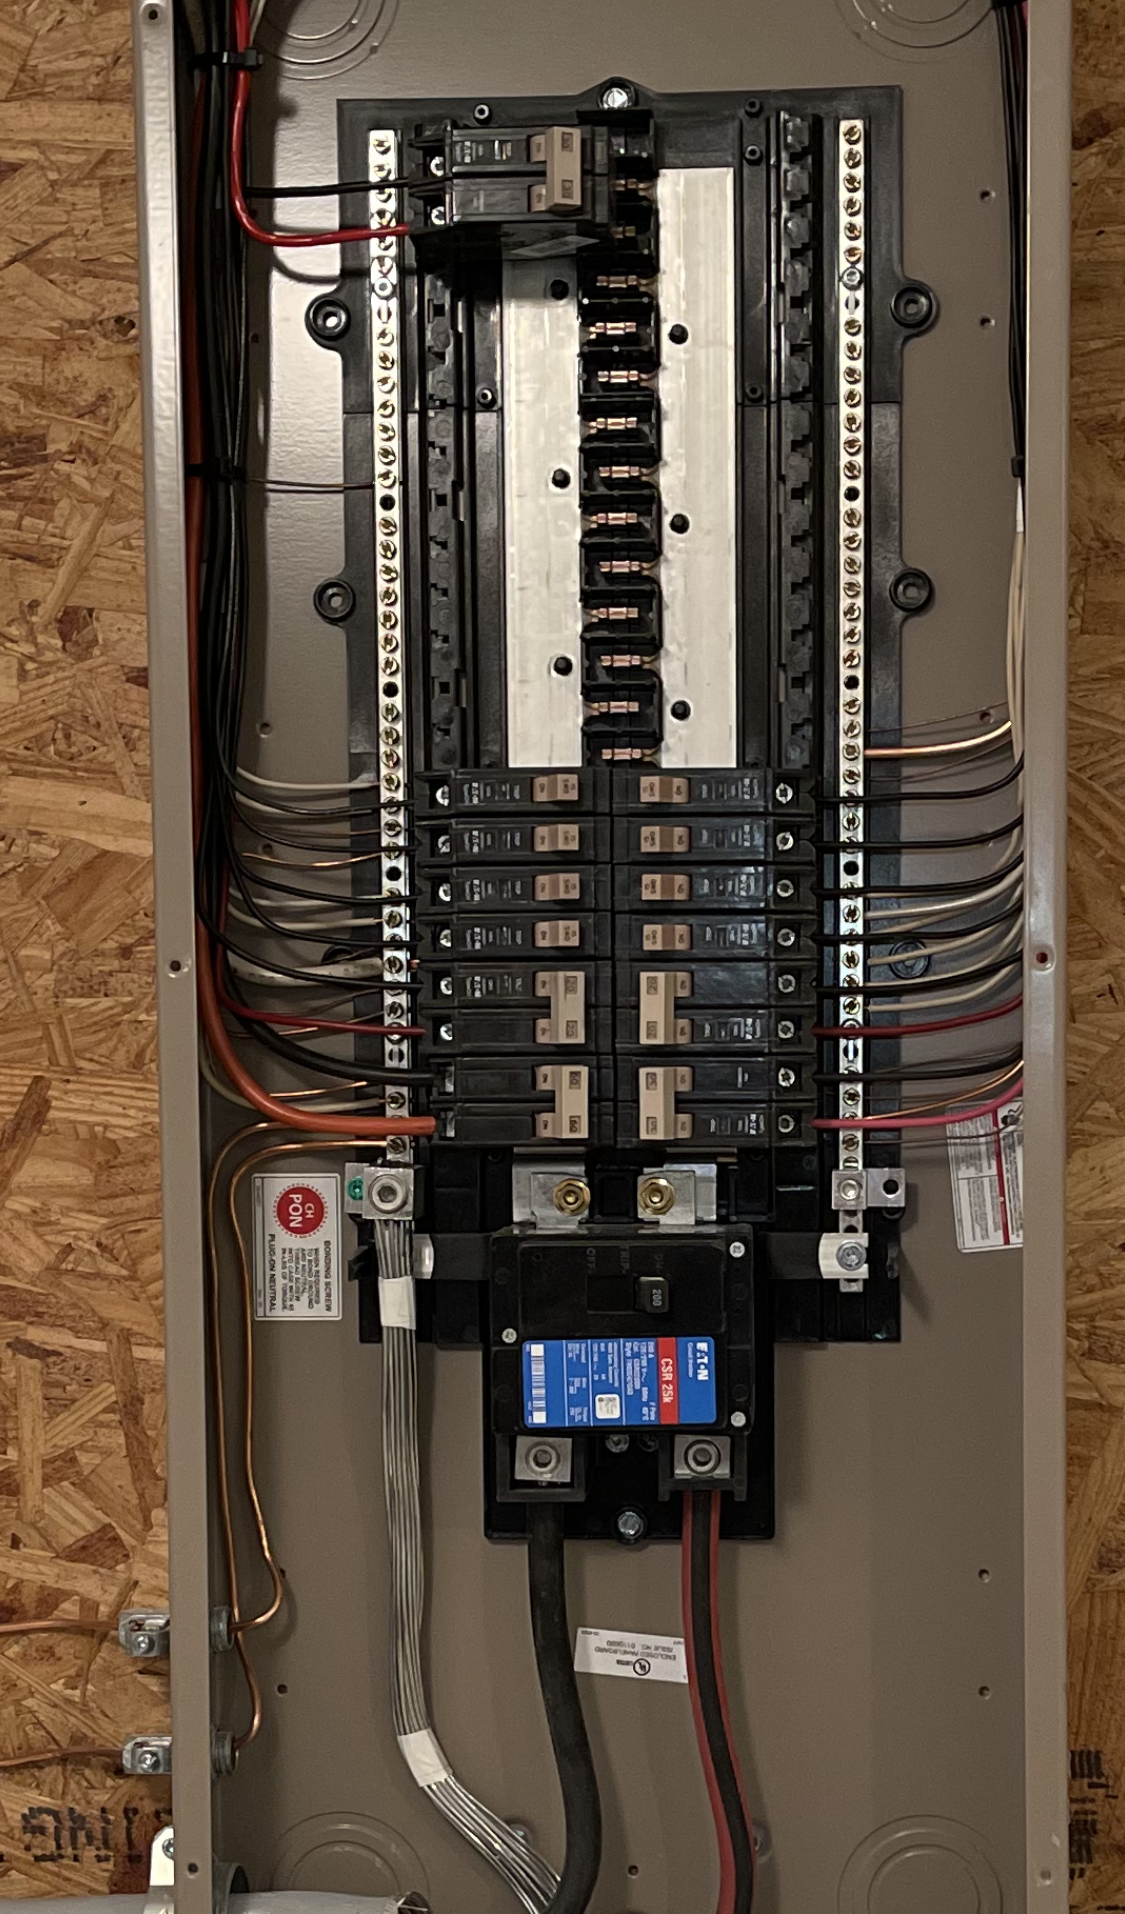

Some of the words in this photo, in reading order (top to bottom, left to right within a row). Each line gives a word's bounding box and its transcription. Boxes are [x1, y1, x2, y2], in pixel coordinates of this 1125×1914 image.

[289, 1194, 303, 1227] PON
[304, 1203, 315, 1218] CH
[268, 1234, 276, 1272] PLUG-ON
[308, 1248, 313, 1257] TO
[587, 1248, 596, 1269] OFF
[652, 1289, 662, 1307] 200
[661, 1358, 673, 1381] CSR
[696, 1342, 709, 1381] EATON
[595, 1646, 638, 1657] PANELBOARD
[640, 1651, 677, 1661] ENCLOSED
